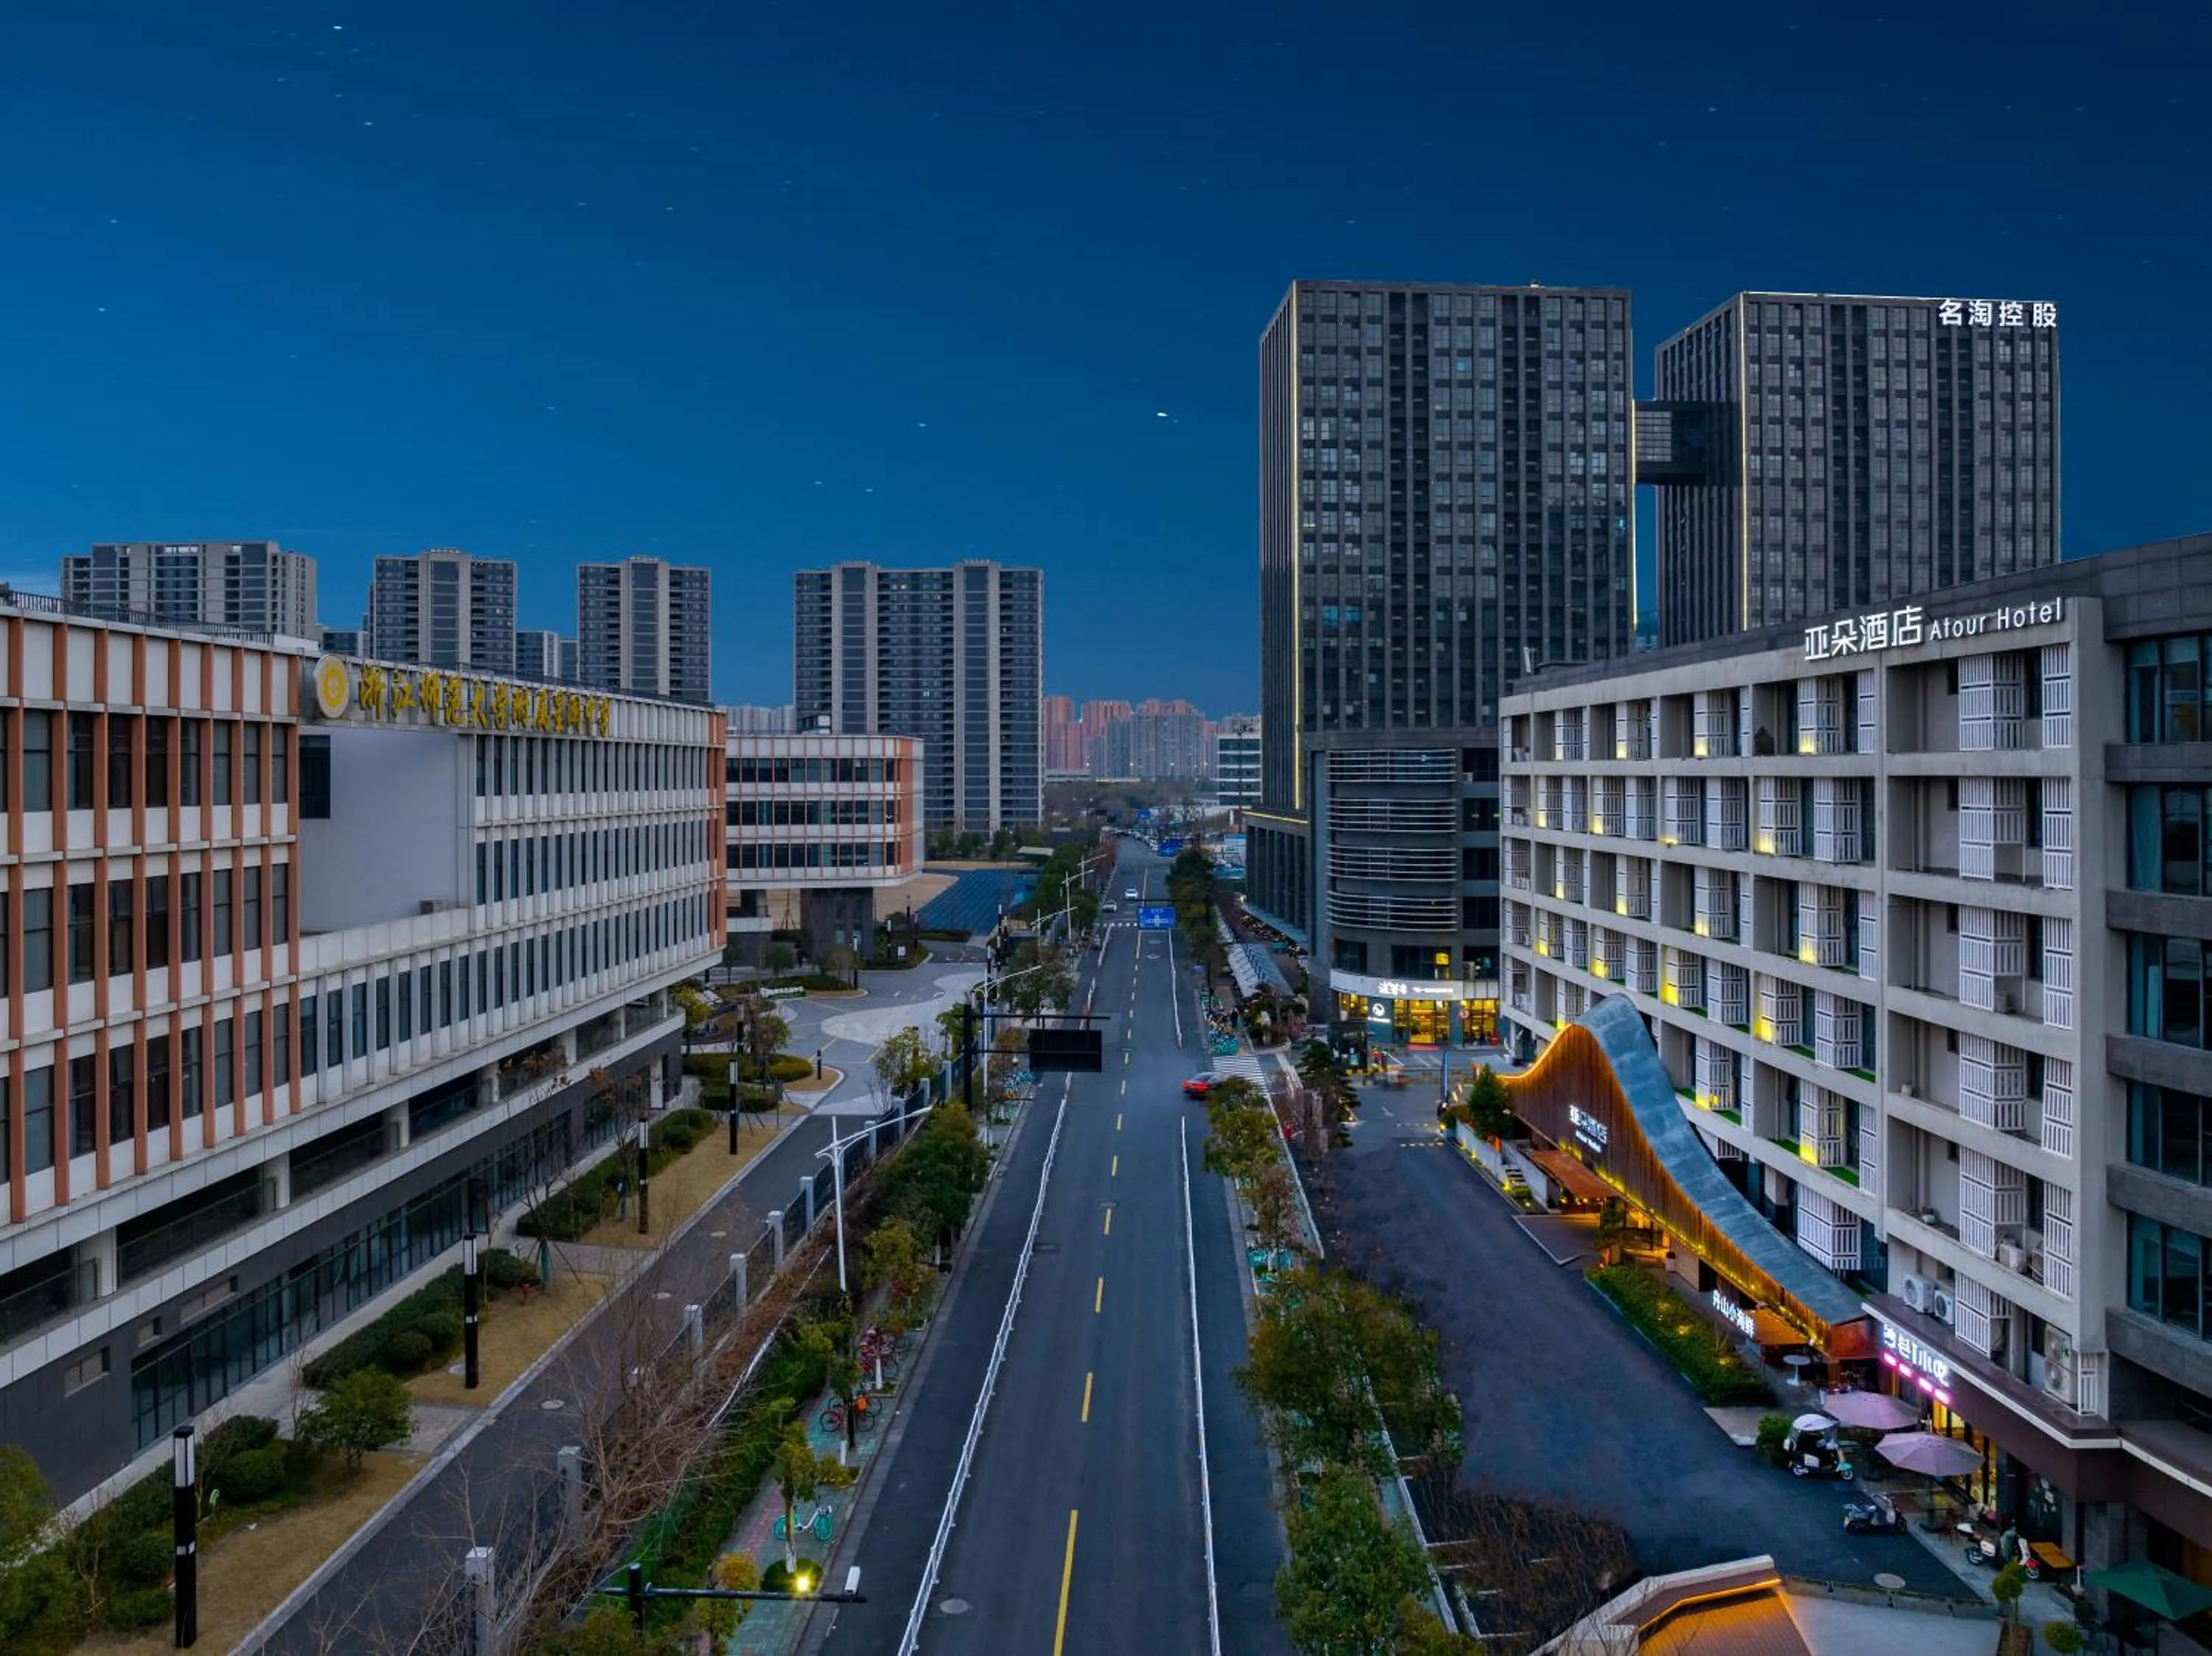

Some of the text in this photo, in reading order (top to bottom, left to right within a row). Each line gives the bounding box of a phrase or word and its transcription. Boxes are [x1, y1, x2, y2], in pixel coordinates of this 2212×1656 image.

[1938, 299, 2057, 328] 名淘控股
[1804, 605, 1924, 661] 亚朵酒店
[1929, 596, 2062, 641] Atour Hotel
